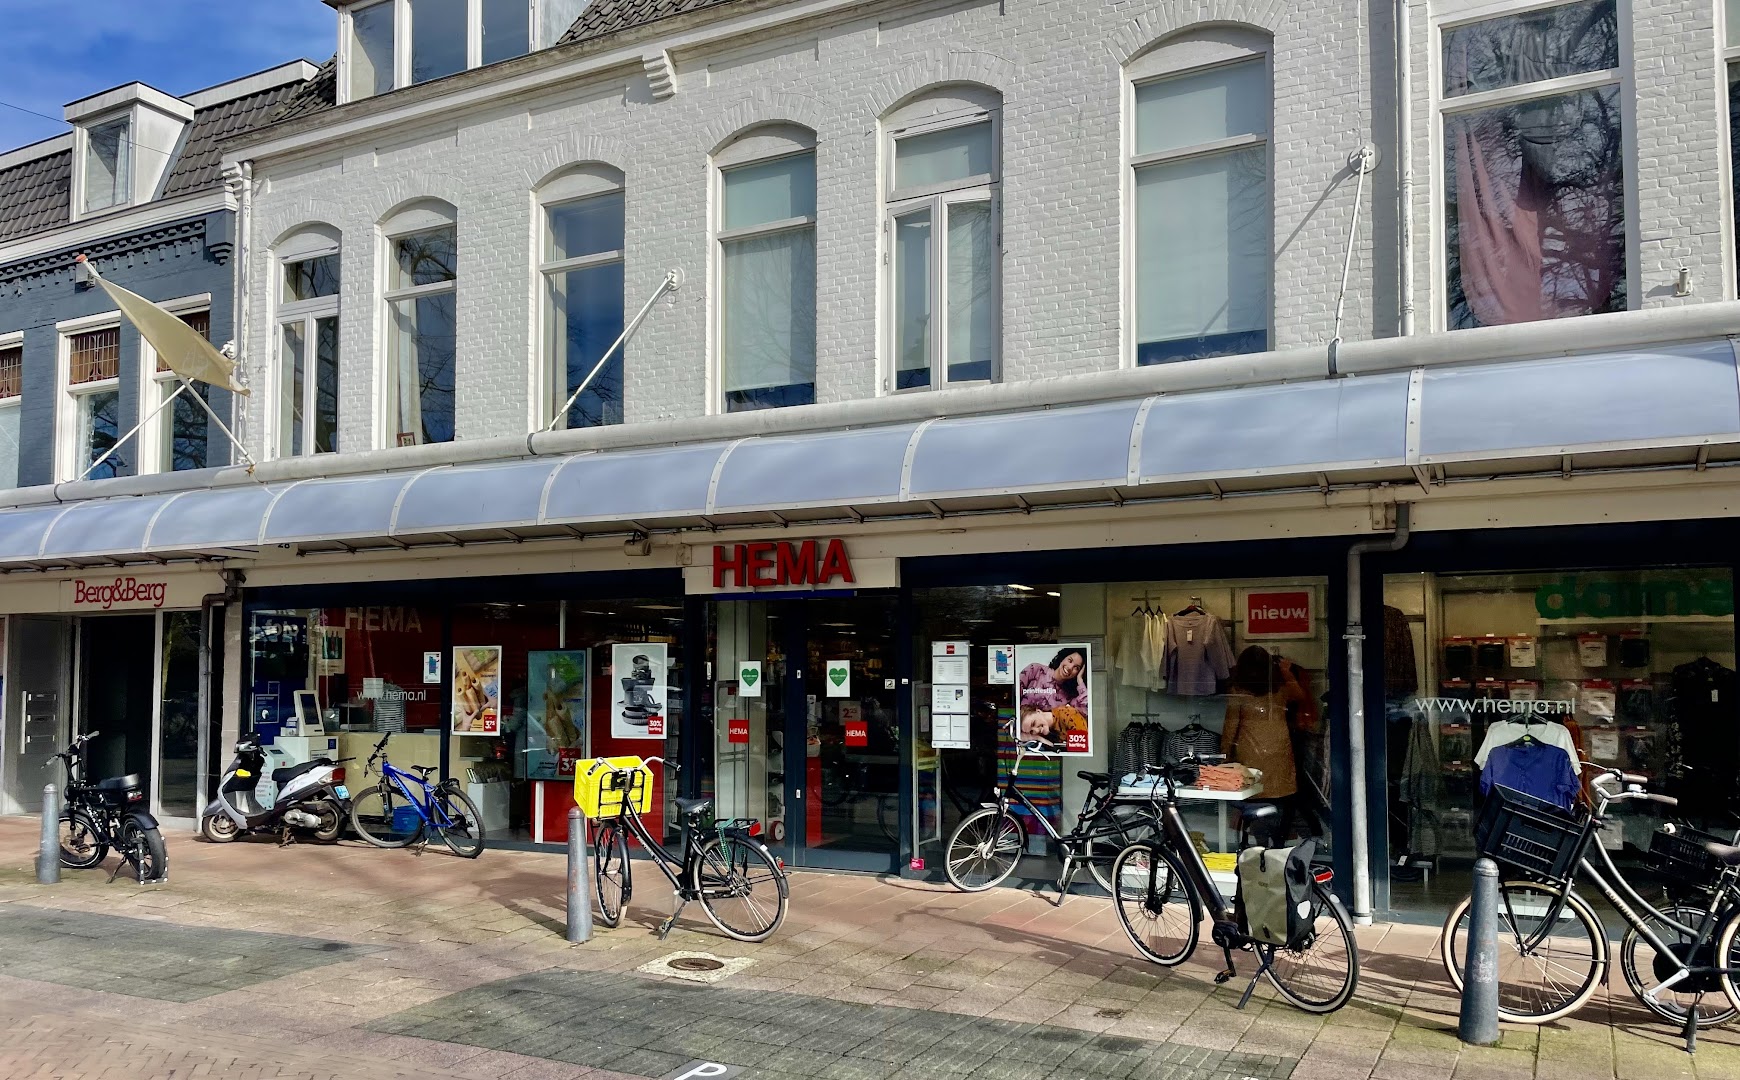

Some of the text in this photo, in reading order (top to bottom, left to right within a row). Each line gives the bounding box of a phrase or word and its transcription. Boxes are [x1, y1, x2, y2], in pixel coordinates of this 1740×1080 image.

[713, 539, 855, 587] HEMA
[75, 578, 167, 609] Berg&Berg
[345, 606, 423, 633] HEMA
[1251, 605, 1307, 619] nieuw
[1415, 697, 1576, 715] www.hema.nl
[1068, 734, 1087, 743] 30%
[673, 1062, 728, 1080] P
